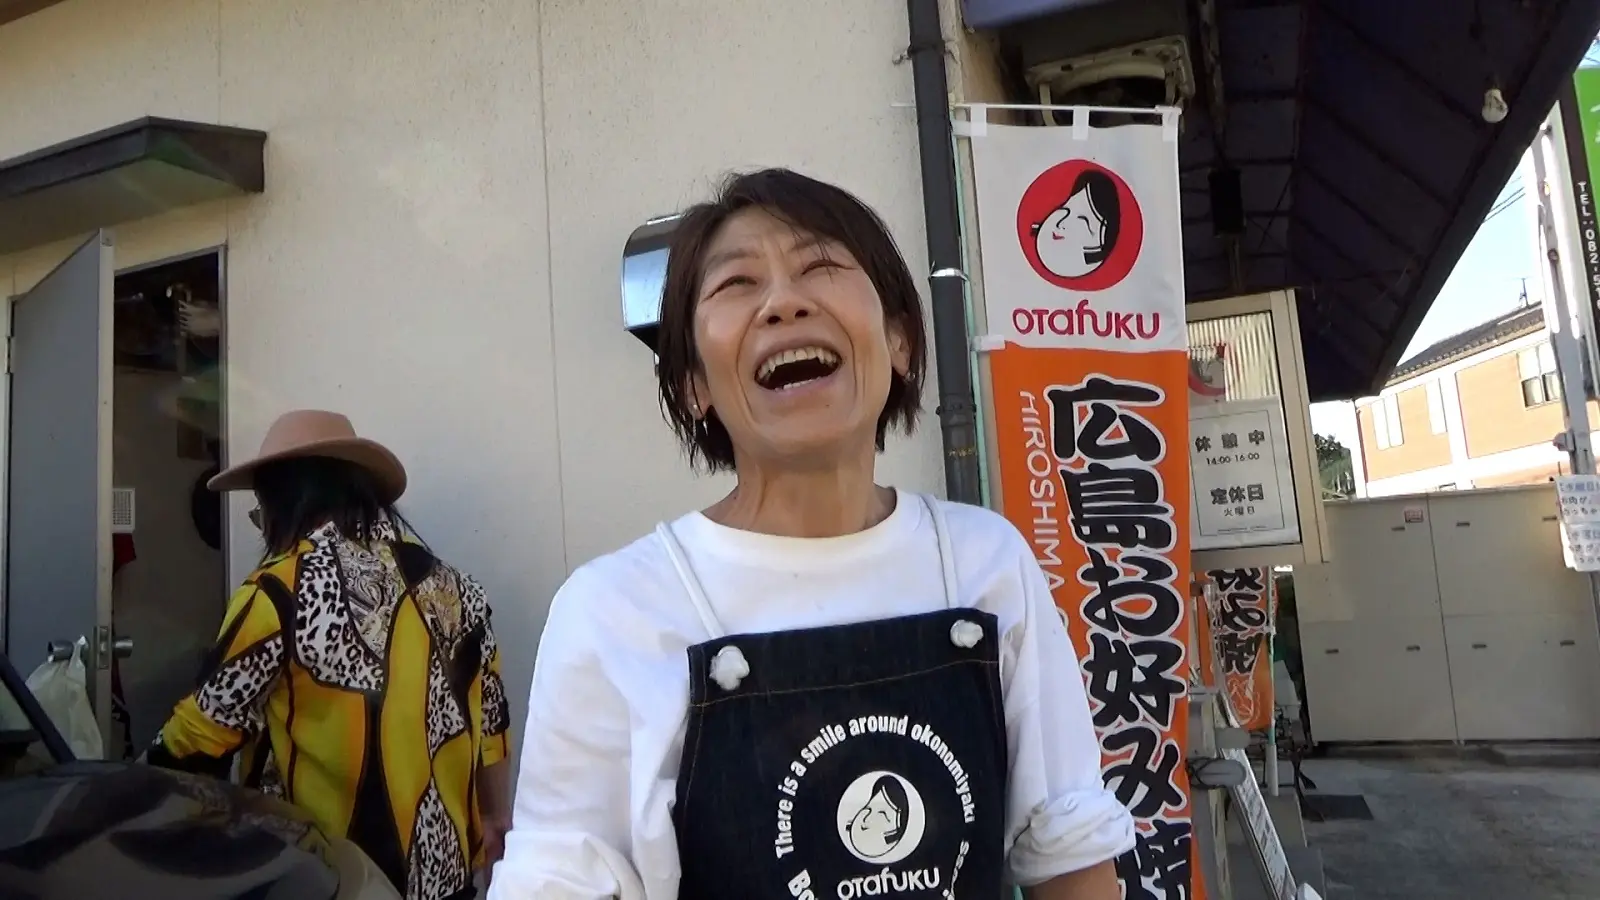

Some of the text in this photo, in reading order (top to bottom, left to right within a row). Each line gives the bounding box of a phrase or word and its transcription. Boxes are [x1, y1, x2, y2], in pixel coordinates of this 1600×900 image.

[1019, 390, 1065, 590] HIROSHIMA
[1210, 484, 1264, 505] 定休日
[775, 715, 976, 859] There is a smile around okonomiyaki
